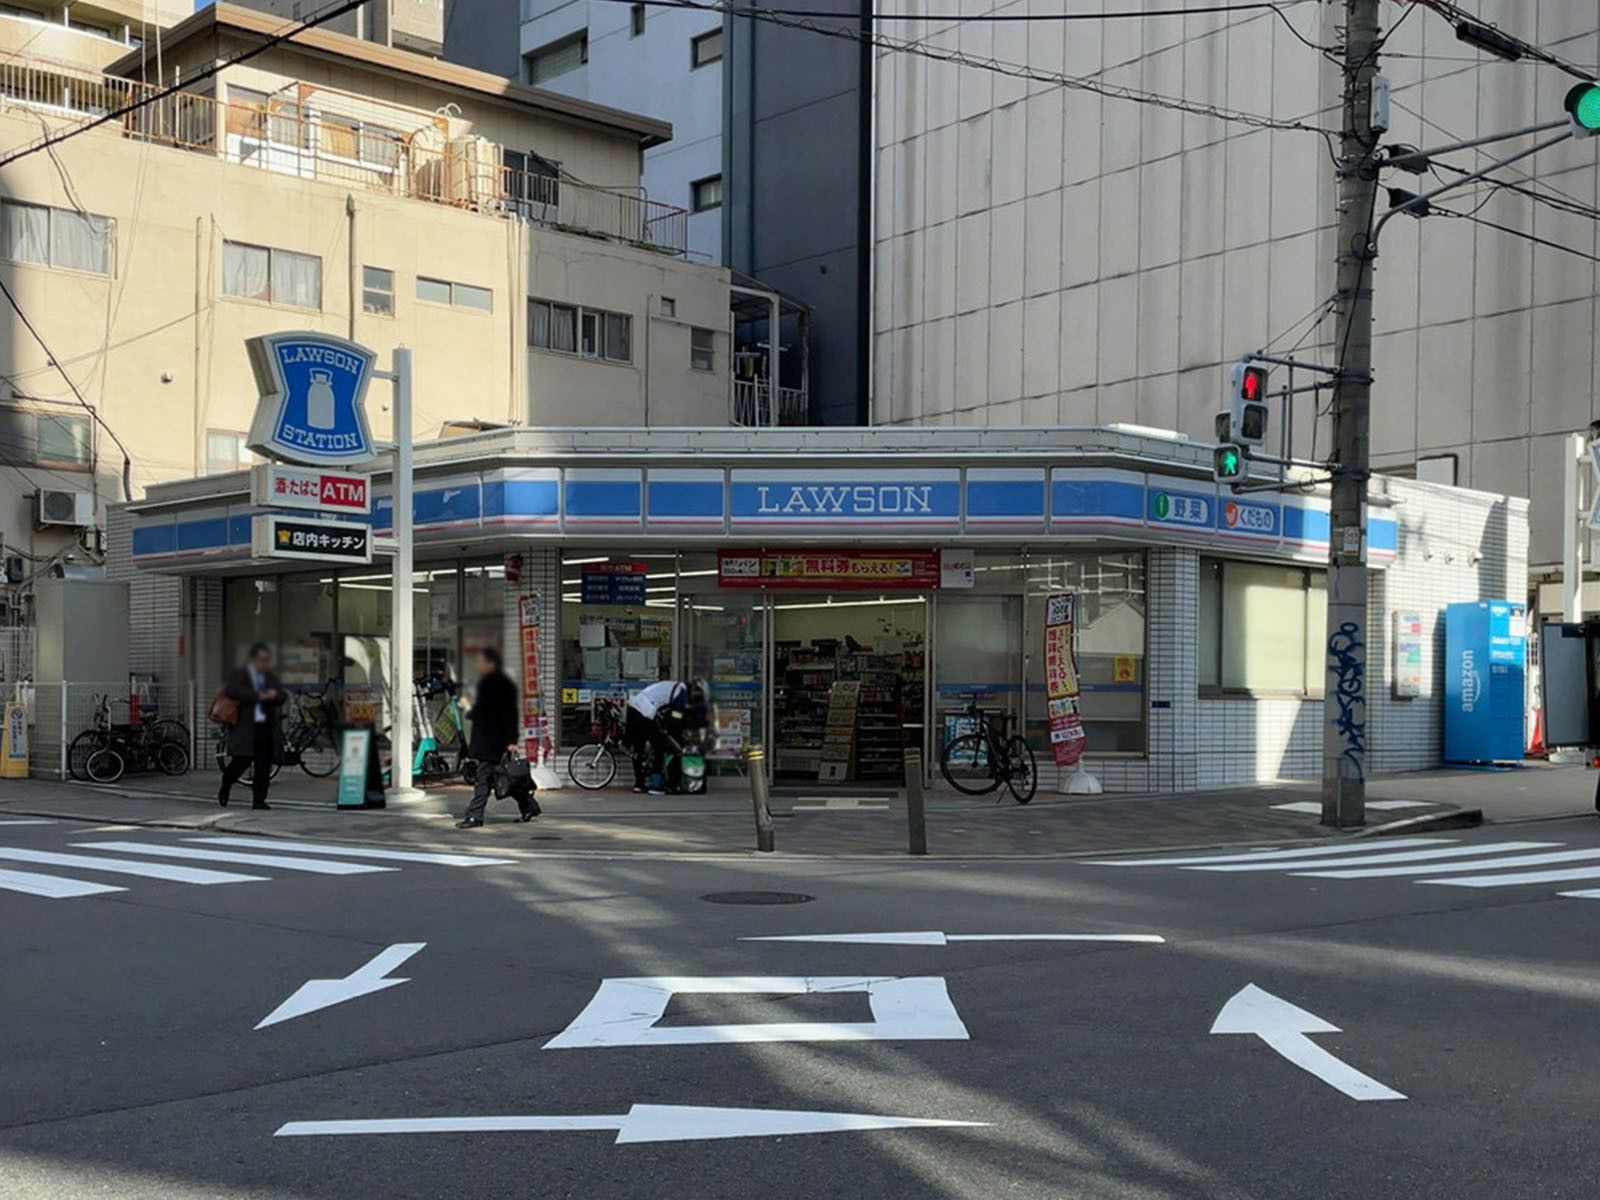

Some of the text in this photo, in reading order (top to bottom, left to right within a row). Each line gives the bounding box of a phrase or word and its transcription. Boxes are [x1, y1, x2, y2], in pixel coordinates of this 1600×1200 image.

[282, 348, 360, 375] LAWSON
[283, 424, 358, 449] STATION
[322, 482, 364, 502] ATM
[757, 486, 932, 512] LAWSON
[1173, 499, 1203, 521] 野菜
[1239, 506, 1273, 527] くだもの
[292, 530, 365, 550] 店内キッチン
[1461, 649, 1475, 713] amazon
